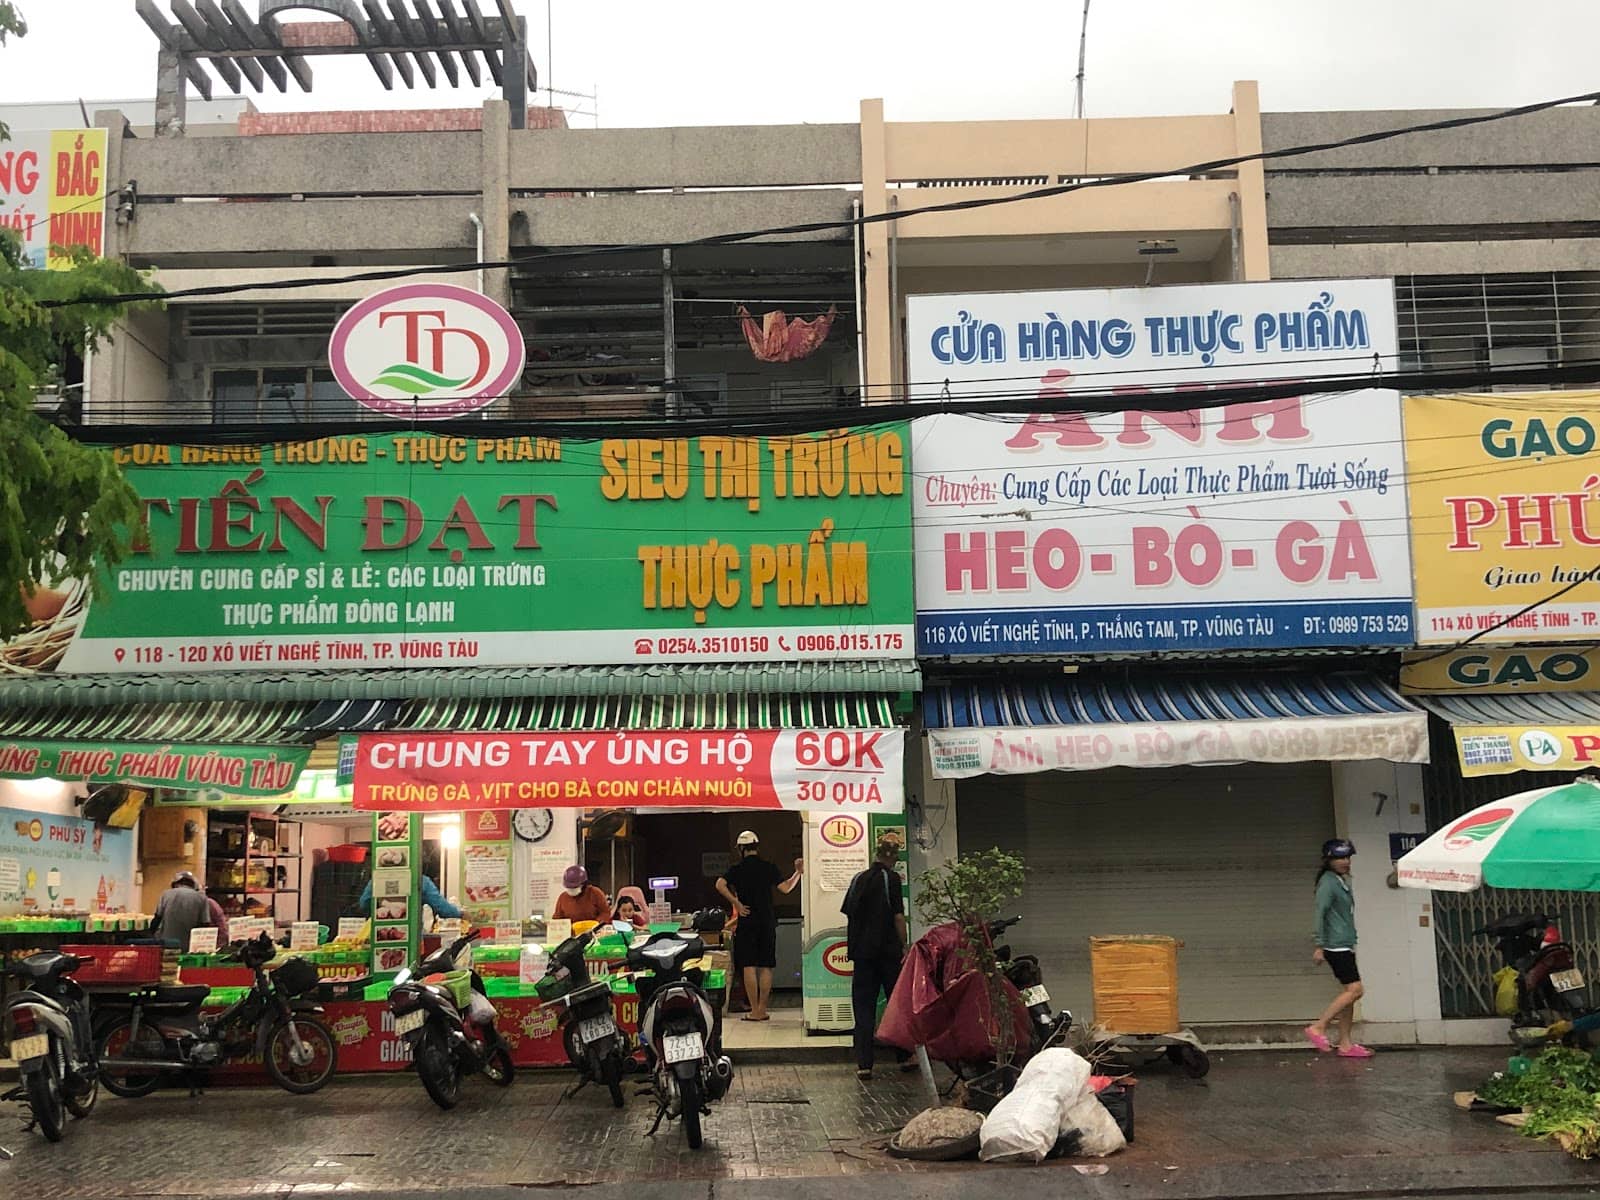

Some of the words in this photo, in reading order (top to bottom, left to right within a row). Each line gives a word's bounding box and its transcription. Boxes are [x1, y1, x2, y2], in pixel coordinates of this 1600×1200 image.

[930, 311, 1006, 363] CỬA
[1018, 312, 1135, 360] HÀNG
[1145, 308, 1245, 367] THỰC
[1254, 292, 1371, 352] PHẨM
[379, 311, 491, 392] TD
[1481, 416, 1595, 461] GẠO
[697, 435, 760, 512] THỊ
[925, 472, 997, 508] Chuyên:
[1003, 471, 1049, 505] Cung
[1055, 465, 1091, 504] Cấp
[1098, 466, 1132, 498] Các
[1137, 463, 1179, 501] Loại
[1185, 466, 1230, 500] Thực
[1236, 460, 1290, 493] Phẩm
[1296, 461, 1337, 491] Tươi
[1343, 457, 1389, 495] Sống
[128, 468, 336, 555] TIẾN
[361, 493, 558, 563] ĐẠT
[944, 528, 1082, 593] HEO
[1132, 505, 1225, 588] BÒ
[1275, 500, 1380, 583] GÀ
[118, 565, 193, 592] CHUYÊN
[201, 567, 253, 590] CUNG
[261, 562, 299, 590] CẤP
[304, 561, 326, 589] SỈ
[331, 569, 346, 588] &
[351, 561, 381, 588] LẺ:
[388, 561, 426, 587] CÁC
[433, 567, 475, 591] LOẠI
[482, 561, 546, 587] TRỨNG
[638, 538, 741, 624] THỰC
[1484, 566, 1541, 588] Giao
[222, 602, 273, 629] THỰC
[280, 594, 338, 626] PHẨM
[345, 599, 398, 623] ĐÔNG
[406, 601, 455, 626] LẠNH
[924, 626, 946, 645] 116
[948, 620, 968, 644] XÔ
[971, 619, 1000, 643] VIẾT
[1002, 619, 1041, 647] NGHỆ
[1045, 618, 1078, 642] TĨNH,
[1081, 621, 1095, 640] P.
[1097, 615, 1144, 639] THẮNG
[1148, 618, 1179, 641] TAM,
[1181, 617, 1202, 637] TP.
[1204, 613, 1242, 637] VŨNG
[1243, 612, 1274, 635] TÀU
[1303, 614, 1327, 634] ĐT:
[1329, 614, 1358, 634] 0989
[1361, 613, 1384, 633] 753
[1386, 612, 1409, 632] 529
[1431, 618, 1454, 633] 114
[1457, 612, 1473, 631] XÔ
[1477, 610, 1503, 630] VIẾT
[1506, 610, 1539, 631] NGHỆ
[1542, 610, 1570, 628] TĨNH
[1581, 611, 1598, 626] TP.
[135, 646, 163, 664] 118
[180, 645, 207, 663] 120
[213, 640, 235, 662] XÔ
[239, 638, 273, 661] VIẾT
[278, 640, 321, 665] NGHỆ
[325, 640, 368, 663] TĨNH,
[373, 642, 395, 659] TP.
[400, 639, 443, 660] VŨNG
[448, 639, 479, 658] TÀU
[658, 636, 769, 655] 0254.3510150
[797, 633, 903, 653] 0906.015.175
[1448, 652, 1589, 687] GẠO
[370, 739, 511, 769] CHUNG
[521, 739, 594, 766] TAY
[607, 731, 691, 765] ỦNG
[701, 733, 753, 773] HỘ
[795, 730, 885, 770] 60K
[1055, 735, 1113, 766] HEO
[1137, 726, 1175, 762] BÒ
[1195, 724, 1236, 761] GÀ
[1250, 728, 1320, 758] 0989
[57, 748, 117, 783] THỰC
[185, 751, 246, 787] VŨNG
[250, 753, 295, 790] TÀU
[368, 778, 439, 803] TRỨNG
[444, 778, 471, 801] GÀ
[518, 781, 561, 800] CHO
[565, 777, 592, 800] BÀ
[596, 779, 639, 799] CON
[643, 775, 701, 798] CHĂN
[705, 776, 753, 798] NUÔI
[798, 781, 826, 801] 30
[831, 777, 883, 804] QUẢ
